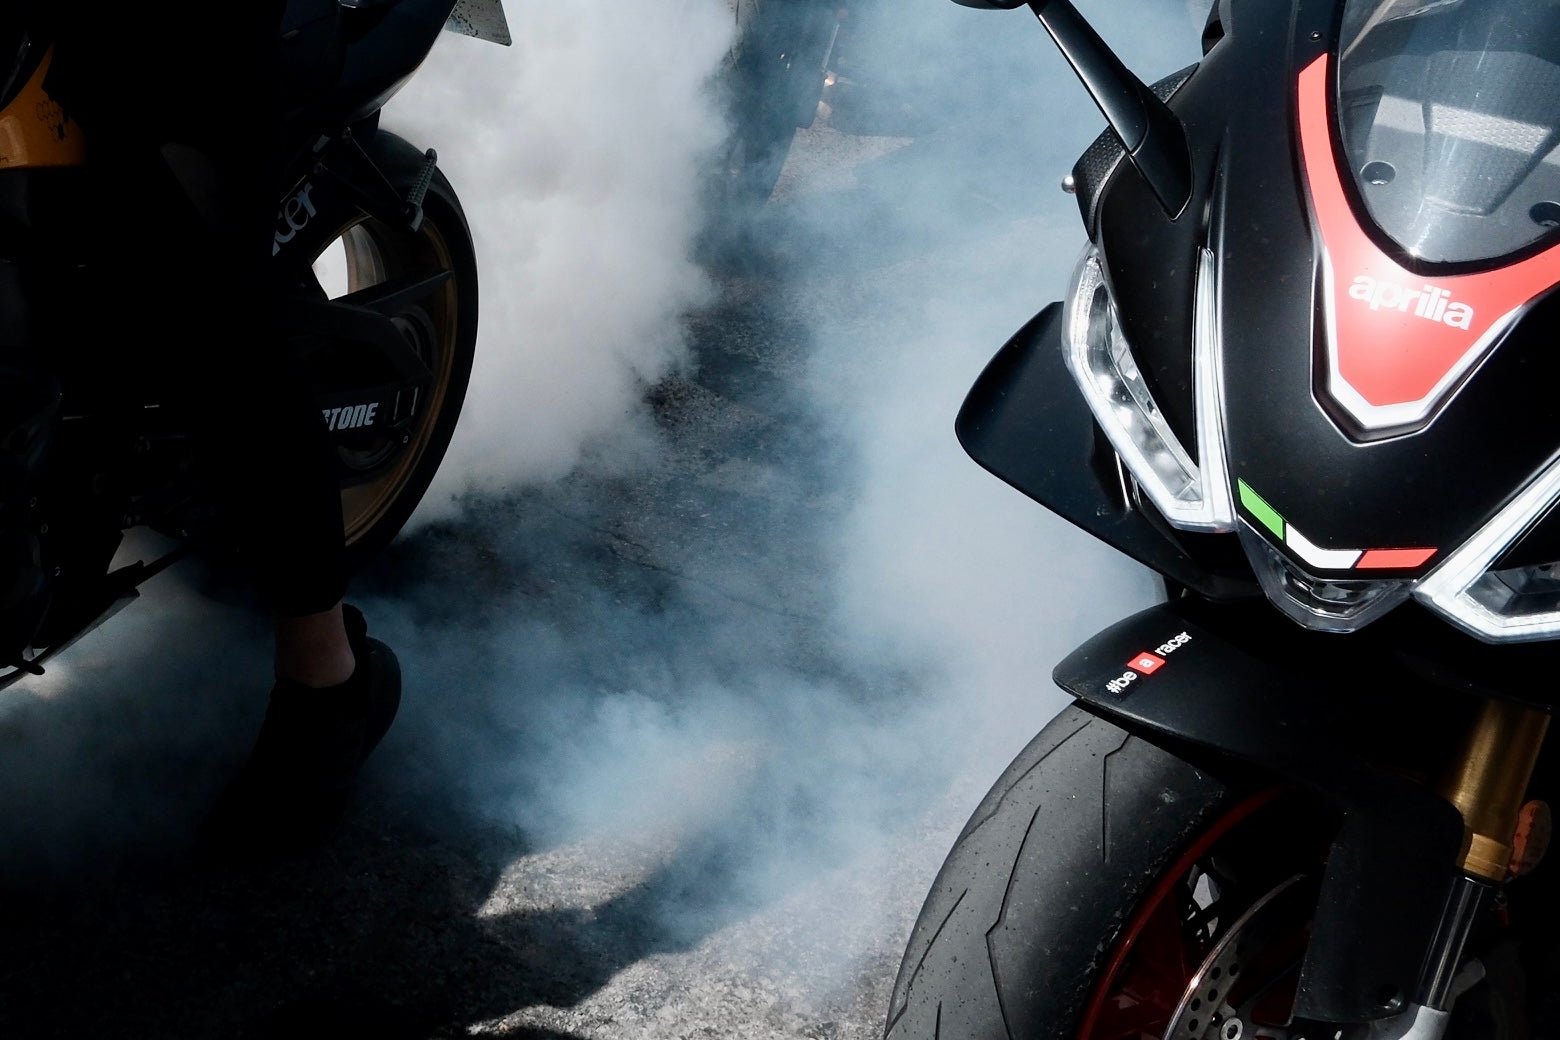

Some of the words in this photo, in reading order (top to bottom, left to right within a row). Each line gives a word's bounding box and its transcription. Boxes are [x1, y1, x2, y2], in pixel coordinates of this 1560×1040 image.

[272, 181, 318, 257] cer
[1347, 274, 1475, 331] aprilia
[1105, 671, 1138, 694] #be
[1138, 657, 1156, 669] a
[1154, 631, 1193, 657] racer
